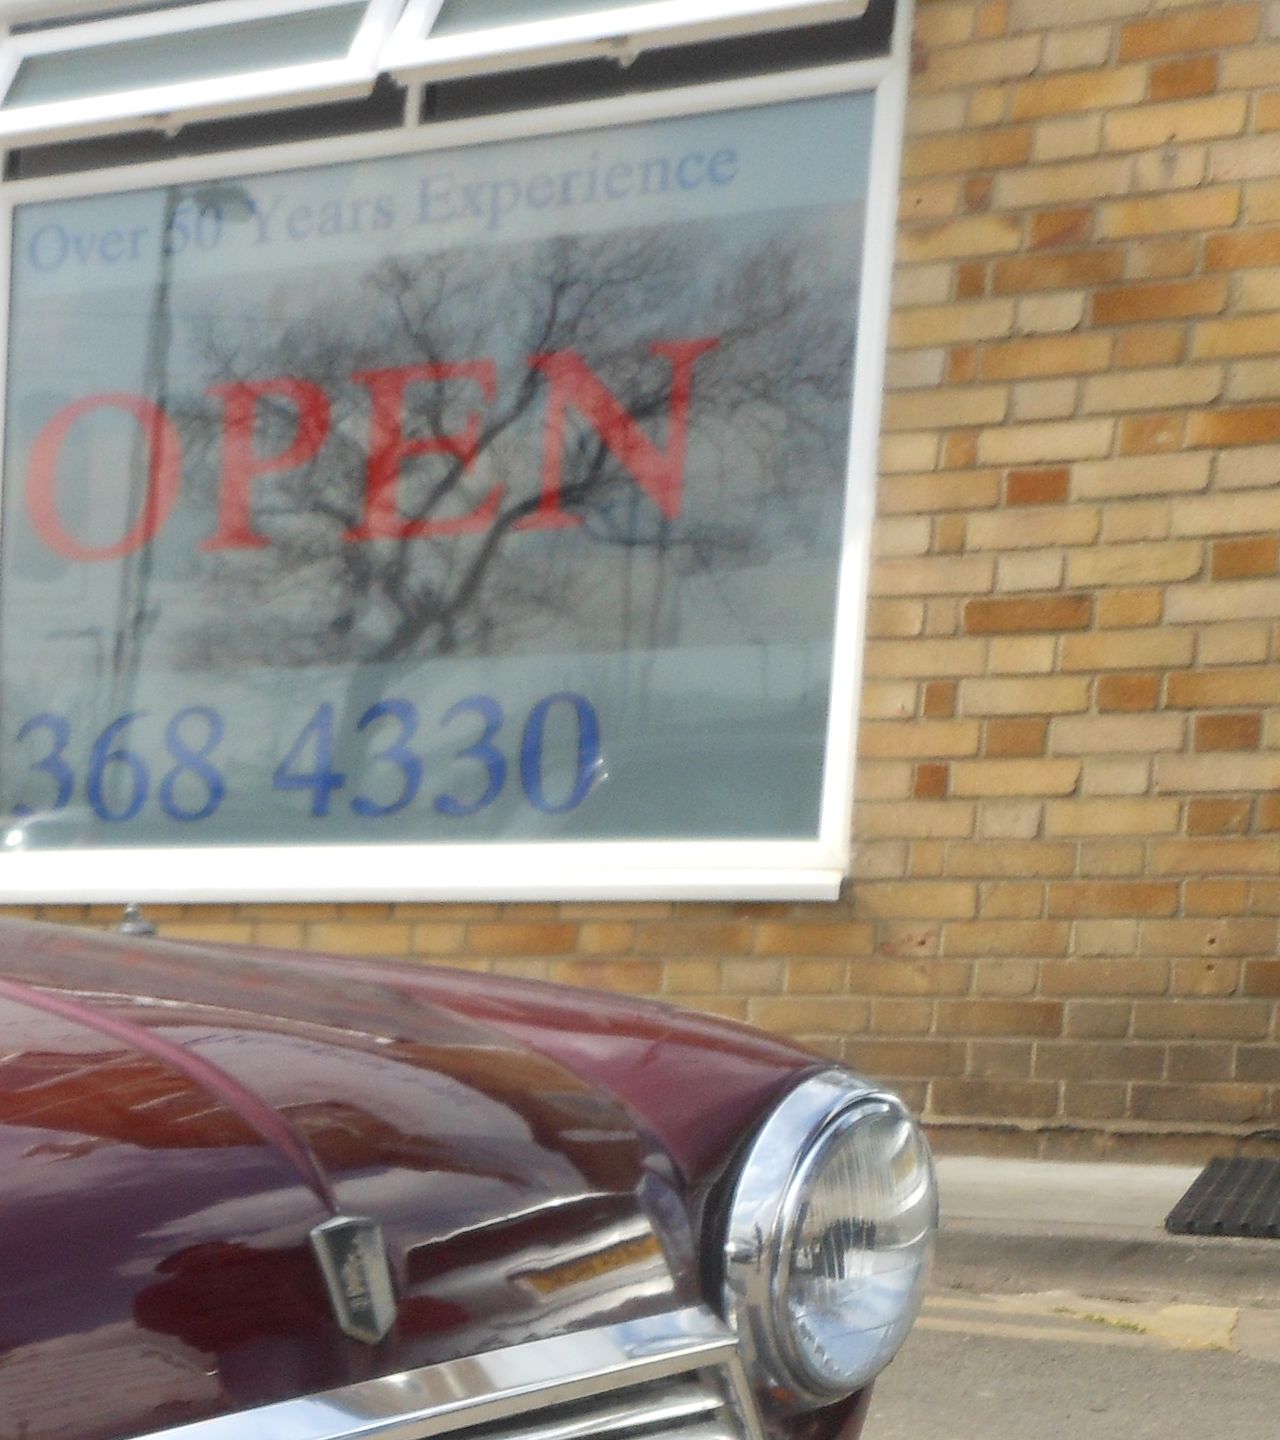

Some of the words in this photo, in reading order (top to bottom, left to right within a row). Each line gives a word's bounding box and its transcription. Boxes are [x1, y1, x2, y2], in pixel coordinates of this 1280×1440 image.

[27, 221, 151, 275] Over
[241, 190, 396, 248] Years
[414, 142, 741, 228] Experience
[24, 337, 721, 563] OPEN
[13, 703, 228, 824] 368
[273, 690, 603, 820] 4330
